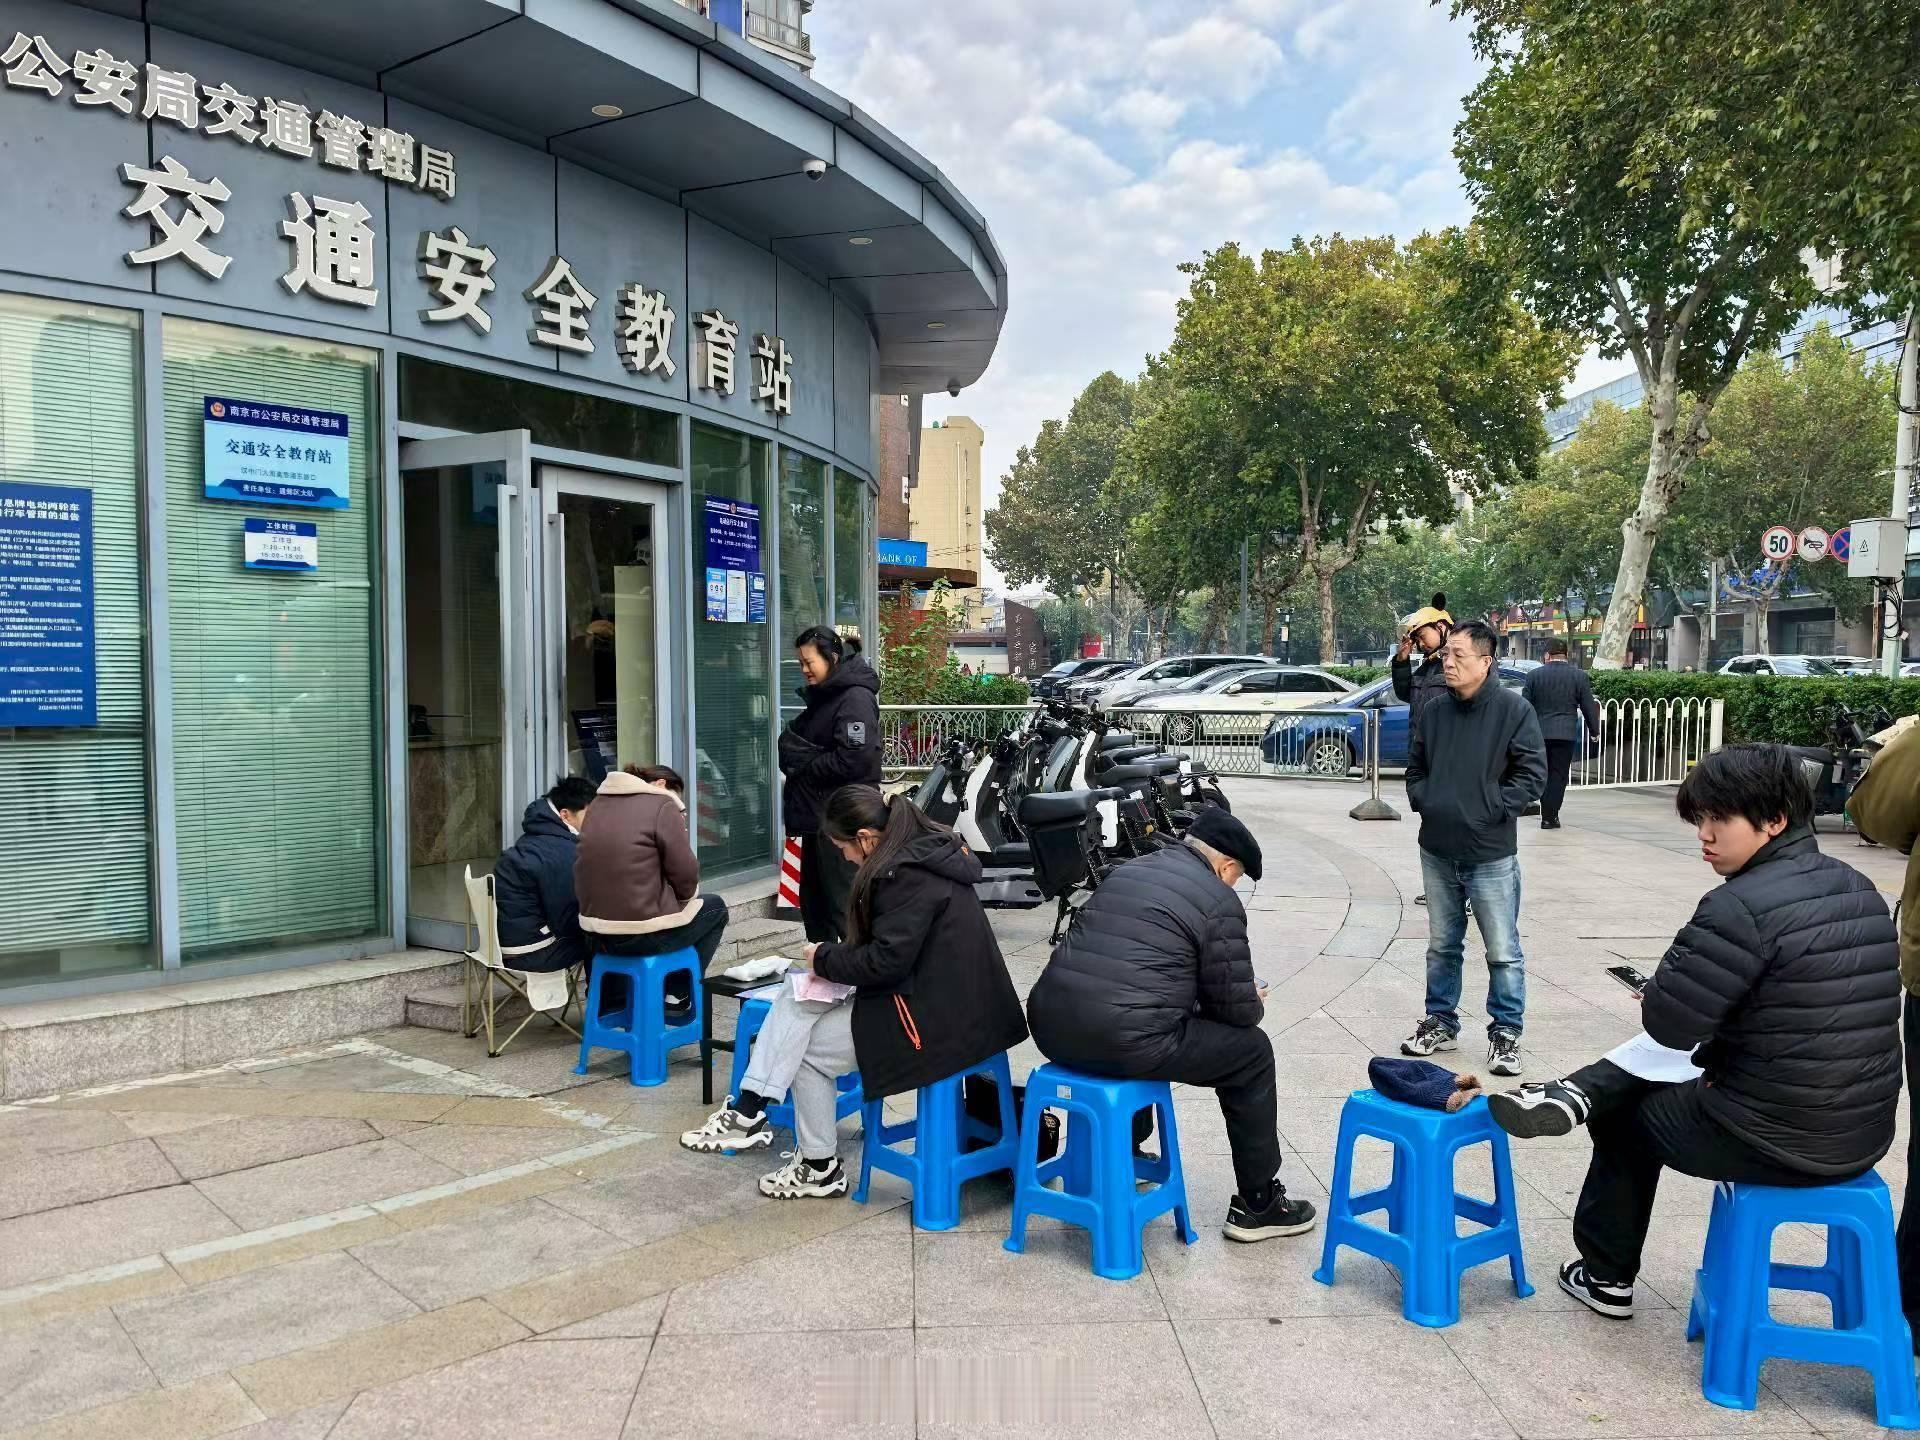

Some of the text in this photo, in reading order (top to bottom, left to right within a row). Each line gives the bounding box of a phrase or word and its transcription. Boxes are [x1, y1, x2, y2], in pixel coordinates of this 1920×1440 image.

[1, 31, 457, 199] 公安局交通管理局
[118, 155, 793, 416] 交通安全教育站
[230, 405, 340, 429] 南京市公安局交通管理局
[226, 439, 332, 464] 交通安全教育站
[0, 499, 80, 512] 息牌电动两轮车
[0, 508, 80, 521] 行车管理的通告
[266, 522, 297, 531] 工作时间
[1769, 535, 1789, 553] 50
[905, 555, 918, 564] OF
